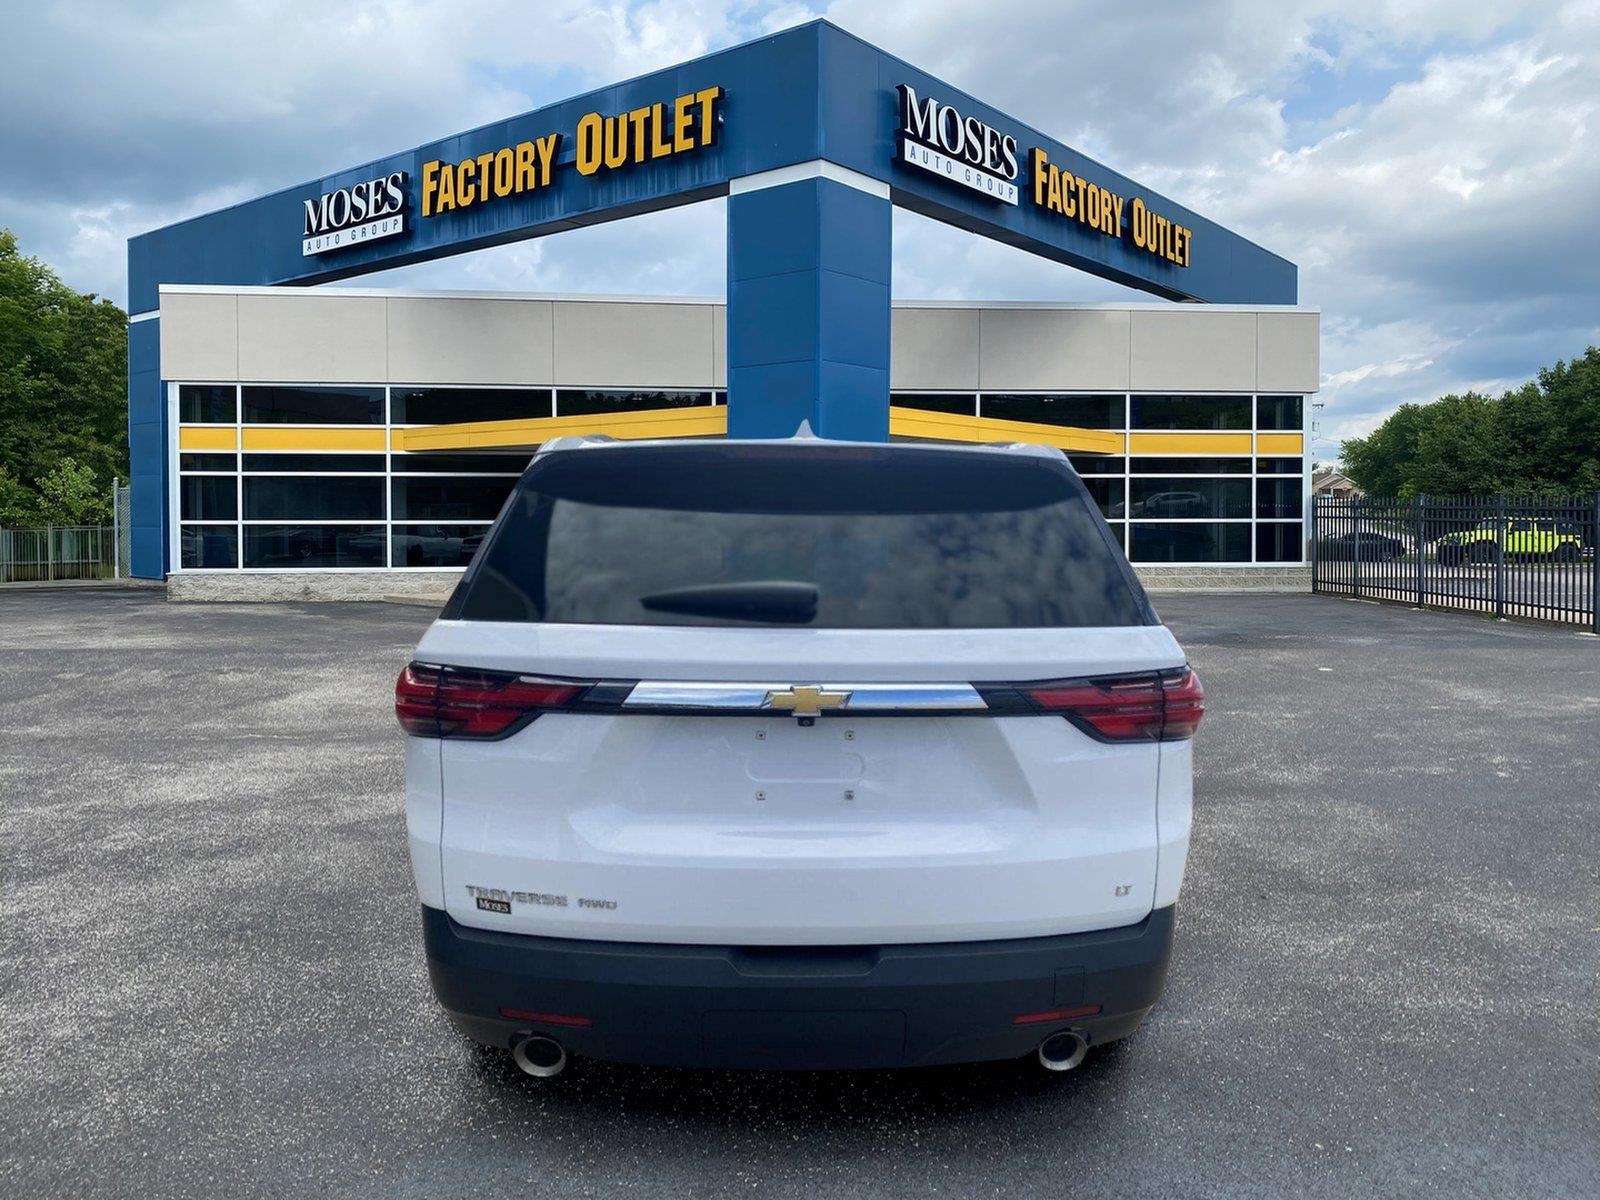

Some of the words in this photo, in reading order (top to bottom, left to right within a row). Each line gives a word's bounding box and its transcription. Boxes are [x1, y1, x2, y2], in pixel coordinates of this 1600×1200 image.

[422, 133, 559, 217] FACTORY
[576, 86, 720, 176] OUTLET
[904, 85, 1018, 180] MOSES
[302, 172, 403, 235] MOSES
[909, 145, 953, 174] AUTO
[965, 169, 1015, 200] GROUP
[306, 235, 341, 252] AUTO
[350, 219, 400, 241] GROUP
[1035, 147, 1124, 239] FACTORY
[1132, 198, 1193, 268] OUTLET
[466, 885, 568, 907] TRAVERSE
[578, 898, 618, 910] AWD
